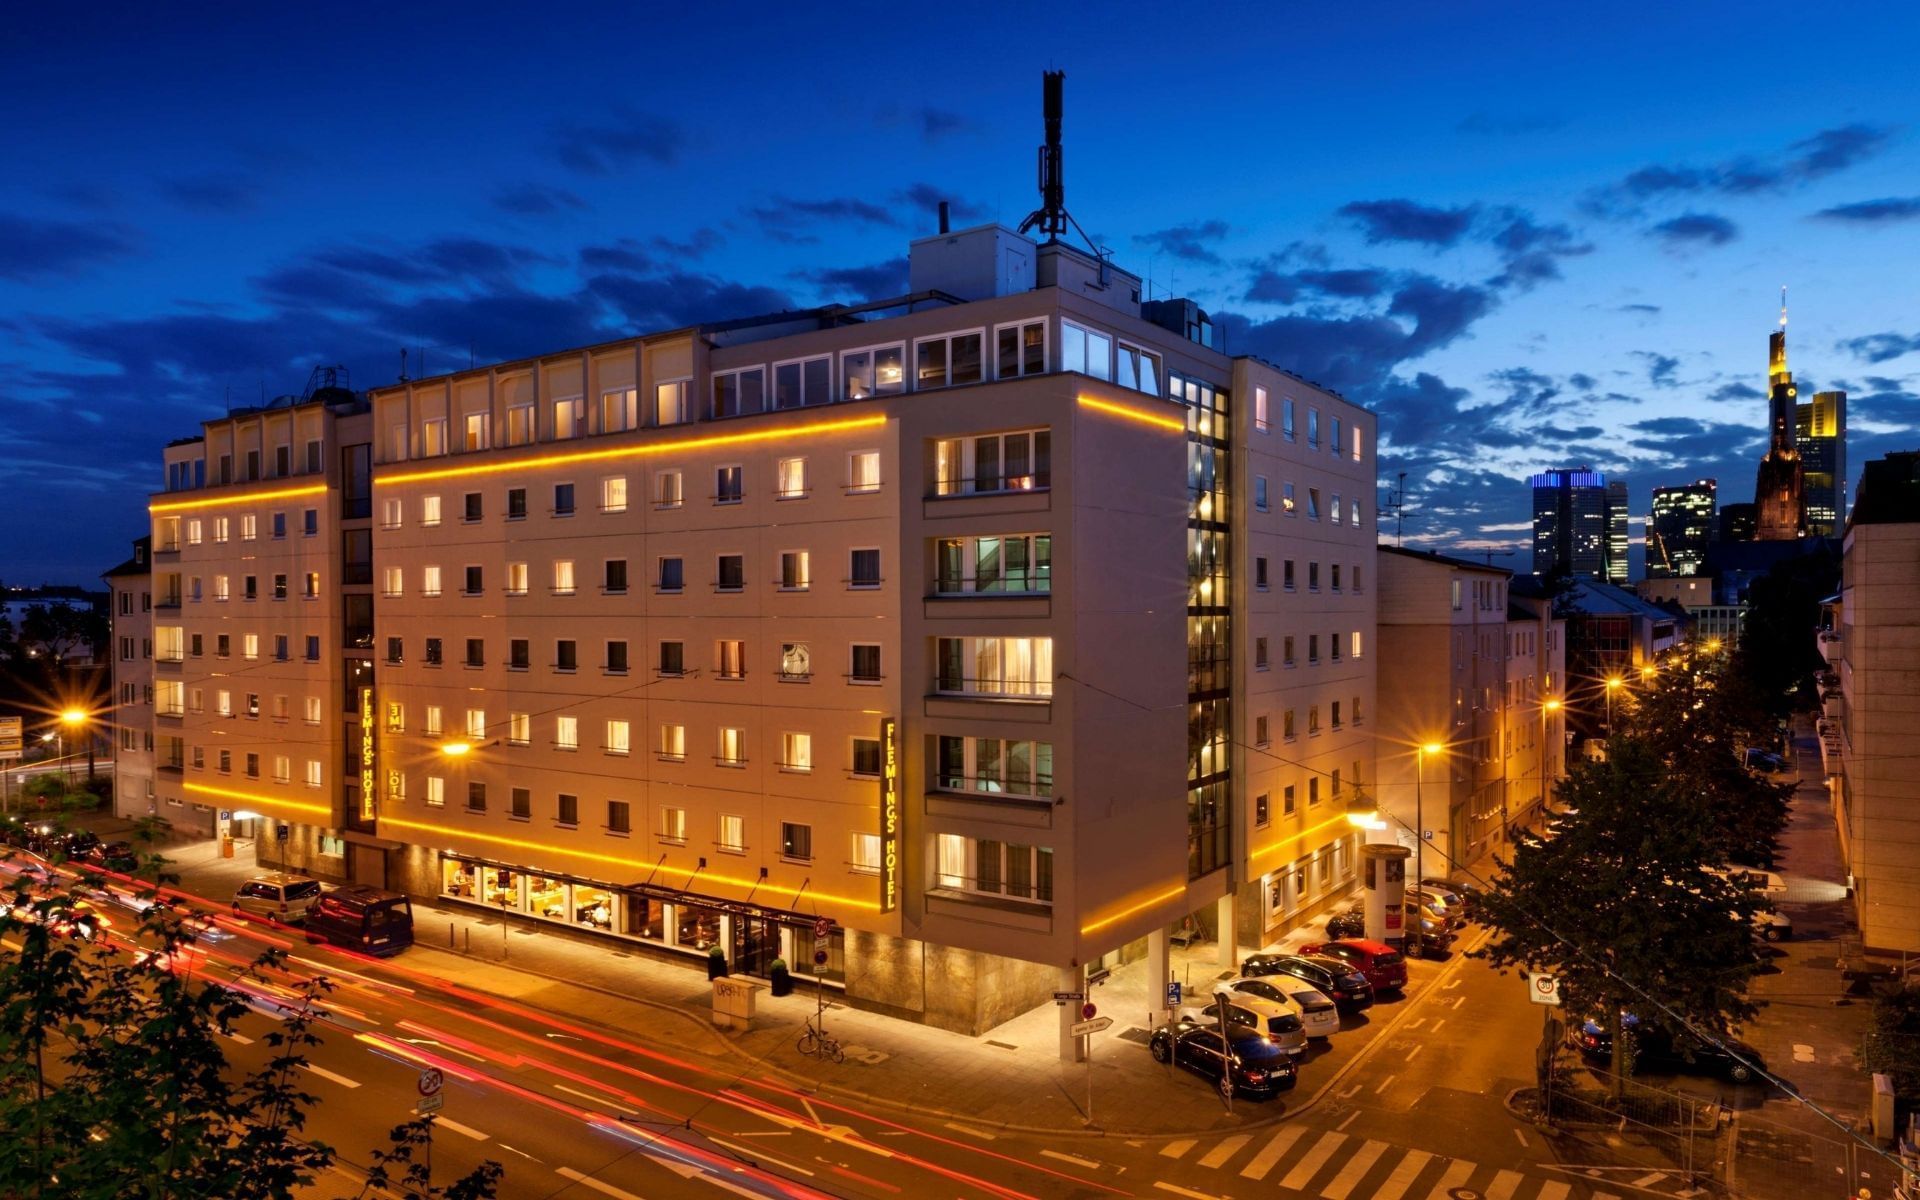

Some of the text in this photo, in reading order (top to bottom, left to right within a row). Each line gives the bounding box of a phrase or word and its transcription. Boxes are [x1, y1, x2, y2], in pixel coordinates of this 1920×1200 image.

[362, 689, 374, 817] FLEMING'S HOTEL
[885, 723, 897, 909] FLEMING'S HOTEL
